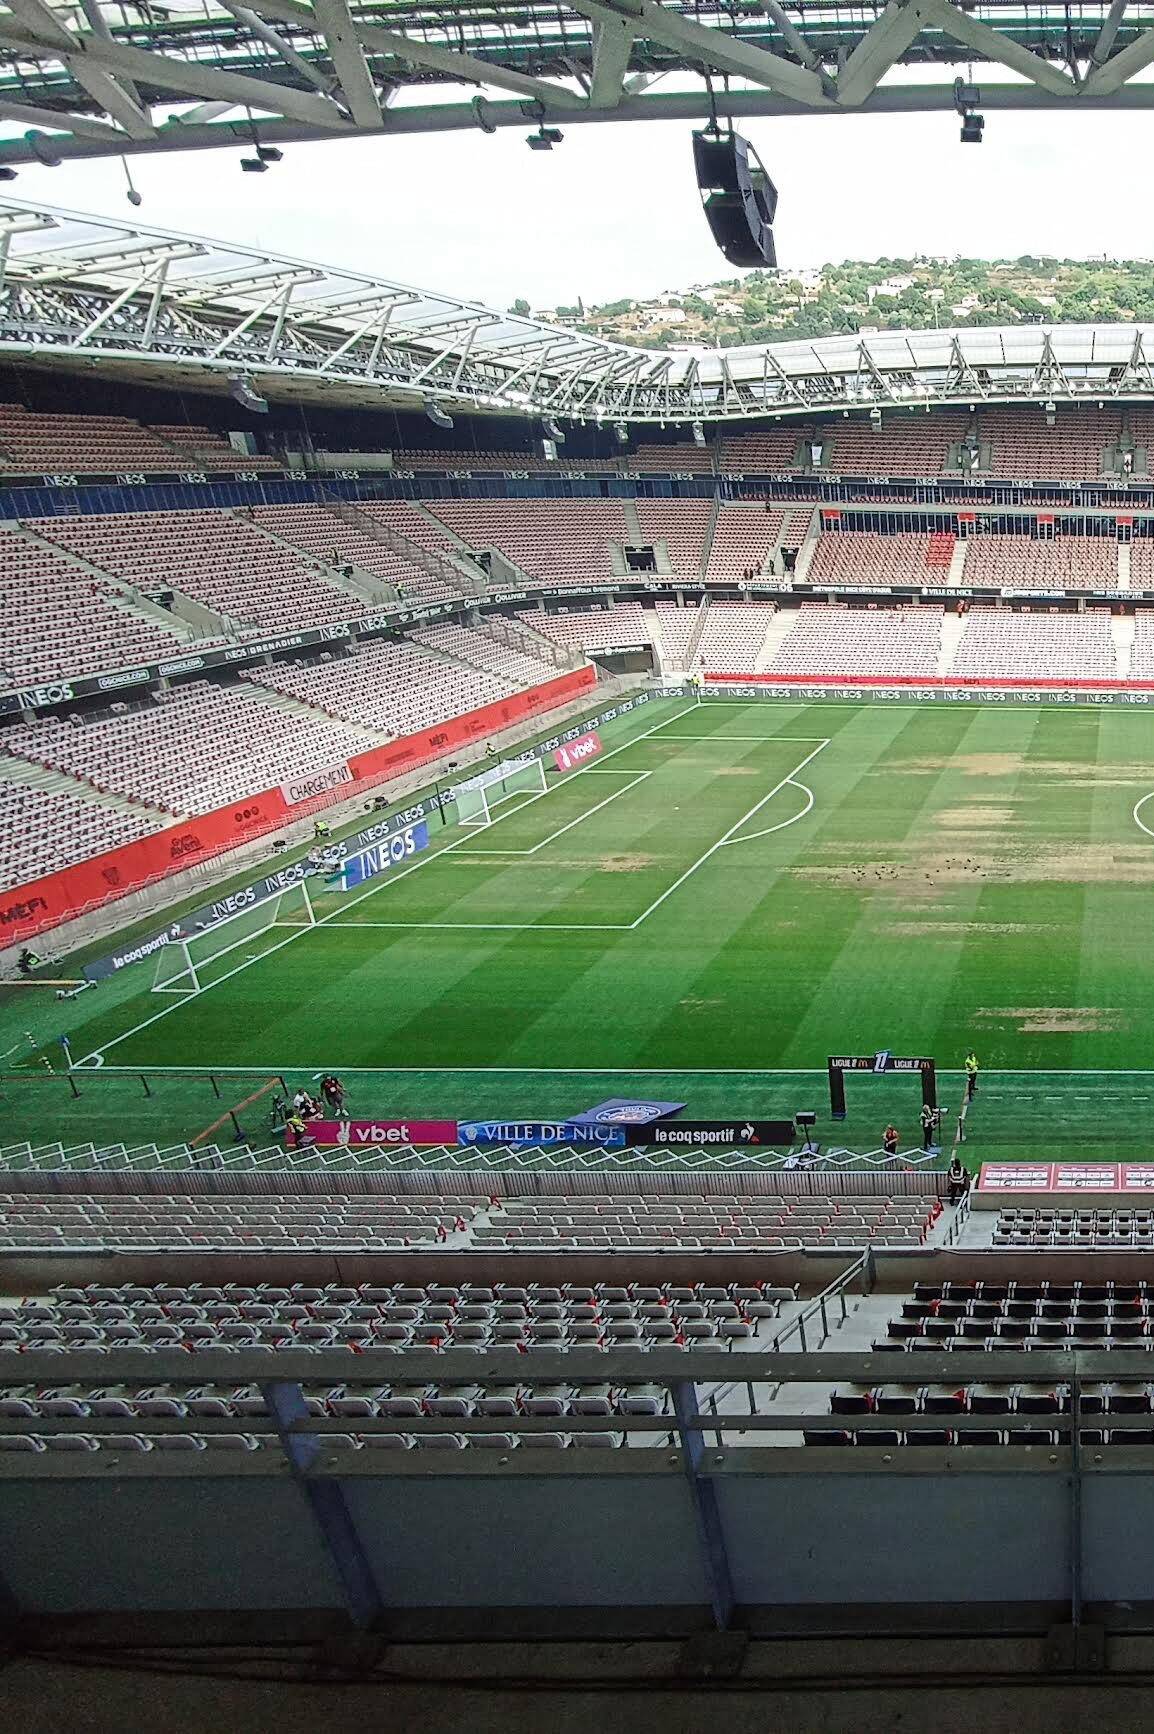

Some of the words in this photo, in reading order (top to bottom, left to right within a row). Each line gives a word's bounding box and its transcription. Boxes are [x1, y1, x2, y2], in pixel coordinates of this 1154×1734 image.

[44, 474, 78, 486] INEOS
[117, 474, 146, 485] INEOS
[179, 473, 206, 484] INEOS
[235, 472, 258, 482] INEOS
[284, 471, 307, 480] INEOS
[335, 470, 359, 480] INEOS
[390, 470, 414, 480] INEOS
[446, 470, 471, 480] INEOS
[504, 470, 529, 480] INEOS
[560, 470, 585, 480] INEOS
[616, 472, 640, 480] INEOS
[670, 472, 693, 480] INEOS
[722, 473, 744, 482] INEOS
[770, 474, 792, 482] INEOS
[819, 475, 841, 484] INEOS
[868, 476, 889, 484] INEOS
[916, 478, 937, 486] INEOS
[964, 478, 985, 487] INEOS
[1012, 480, 1033, 488] INEOS
[1060, 481, 1081, 490] INEOS
[1107, 482, 1128, 490] INEOS
[359, 617, 387, 632] INEOS
[319, 625, 350, 642] INEOS
[225, 649, 247, 660] INEOS
[250, 637, 302, 654] GRENADIER
[18, 684, 74, 709] INEOS
[655, 688, 684, 698] INEOS
[727, 688, 755, 697] INEOS
[763, 689, 790, 698] INEOS
[798, 690, 826, 698] INEOS
[834, 690, 862, 699] INEOS
[872, 690, 900, 700] INEOS
[908, 691, 936, 700] INEOS
[943, 691, 972, 700] INEOS
[978, 692, 1006, 701] INEOS
[1013, 692, 1040, 702] INEOS
[1048, 693, 1076, 702] INEOS
[1086, 694, 1114, 703] INEOS
[1121, 694, 1148, 704] INEOS
[619, 700, 634, 715] INEOS
[602, 708, 617, 723] INEOS
[583, 717, 600, 732] INEOS
[562, 726, 580, 742] INEOS
[540, 736, 560, 753] INEOS
[570, 737, 598, 760] vbet
[290, 766, 350, 800] CHARGEMENT
[395, 804, 424, 826] INEOS
[358, 821, 389, 846] INEOS
[361, 829, 415, 880] INEOS
[213, 887, 257, 917] INEOS
[113, 956, 125, 968] le
[125, 948, 143, 964] coq
[142, 932, 170, 954] sportif
[832, 1059, 851, 1068] LIGUE
[894, 1060, 914, 1069] LIGUE
[356, 1125, 410, 1142] vbet
[484, 1126, 533, 1141] VILLE
[541, 1126, 564, 1141] DE
[573, 1126, 618, 1141] NICE
[656, 1128, 668, 1141] le
[668, 1131, 692, 1144] coq
[693, 1128, 734, 1144] sportif
